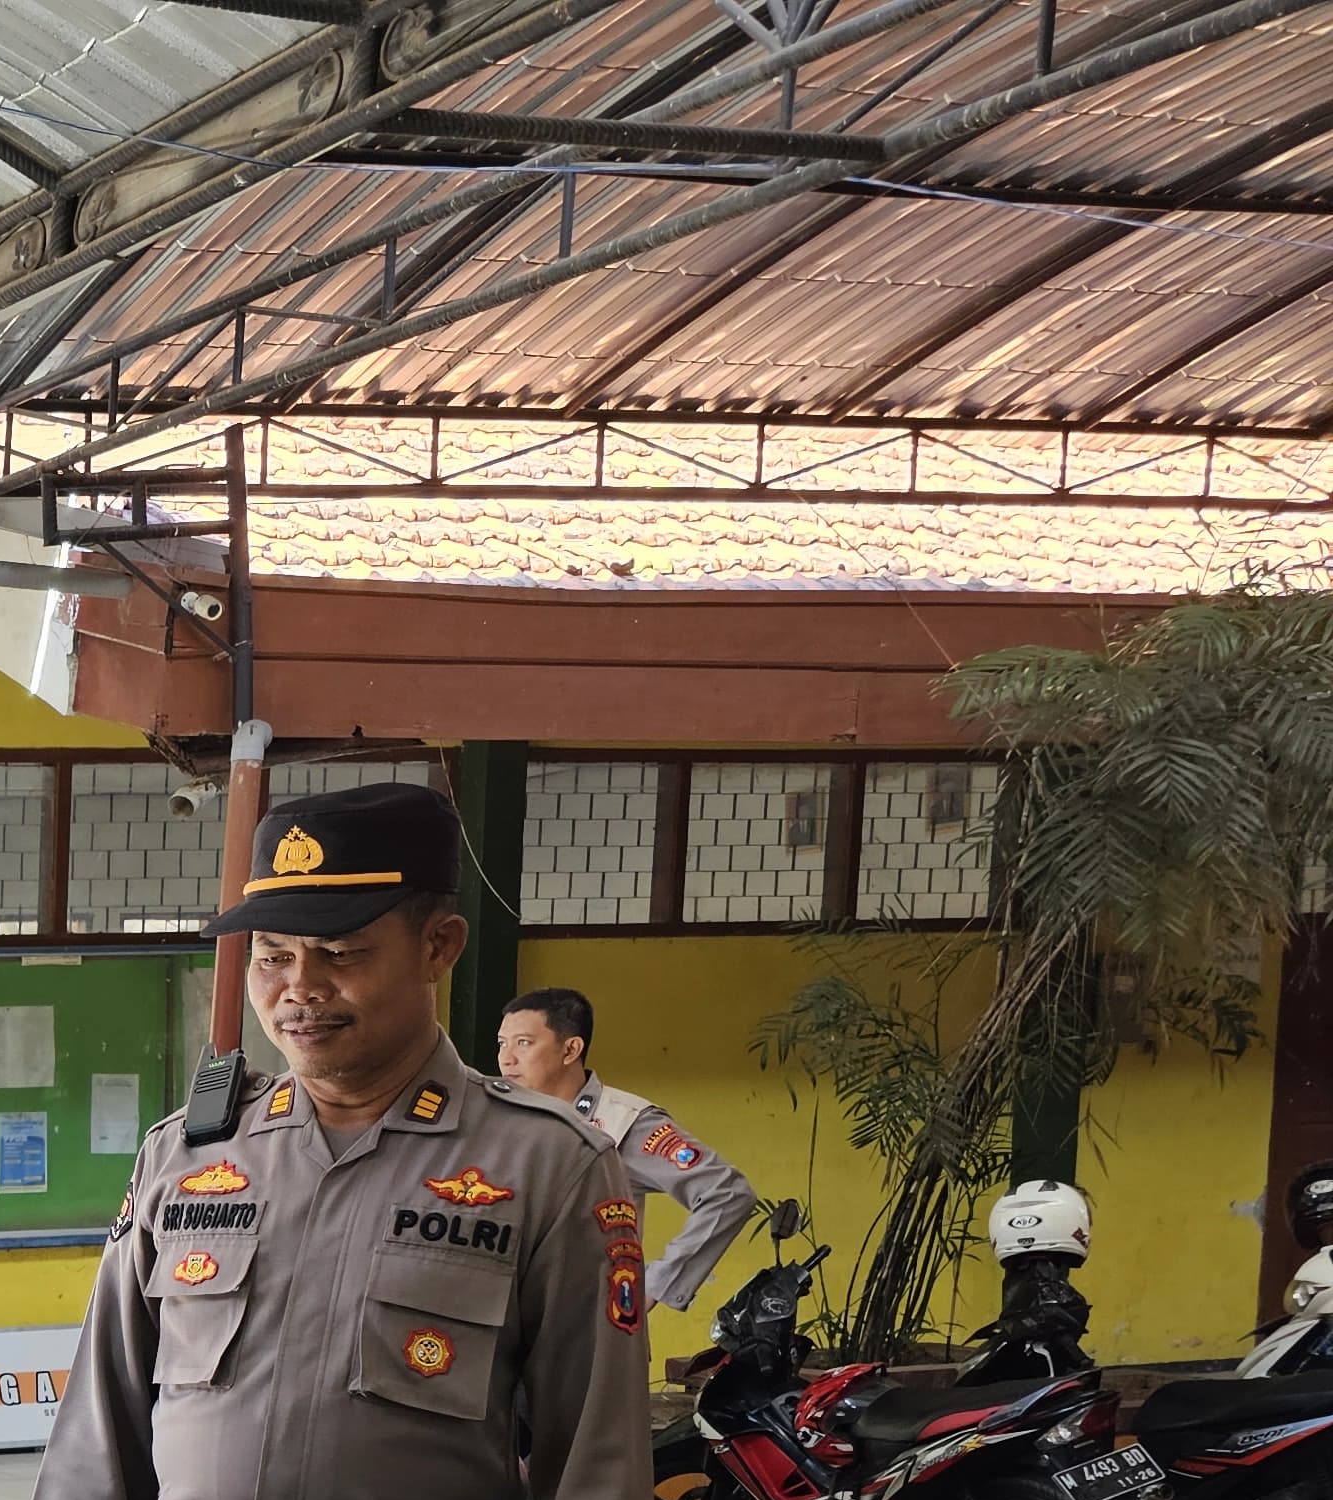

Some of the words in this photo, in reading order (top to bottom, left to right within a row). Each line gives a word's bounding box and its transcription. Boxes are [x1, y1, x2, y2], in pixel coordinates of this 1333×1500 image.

[162, 1203, 185, 1232] SRI
[183, 1202, 257, 1230] SUGIARTO
[393, 1209, 512, 1255] POLRI
[1082, 1458, 1120, 1481] 4493
[1121, 1448, 1147, 1467] BD
